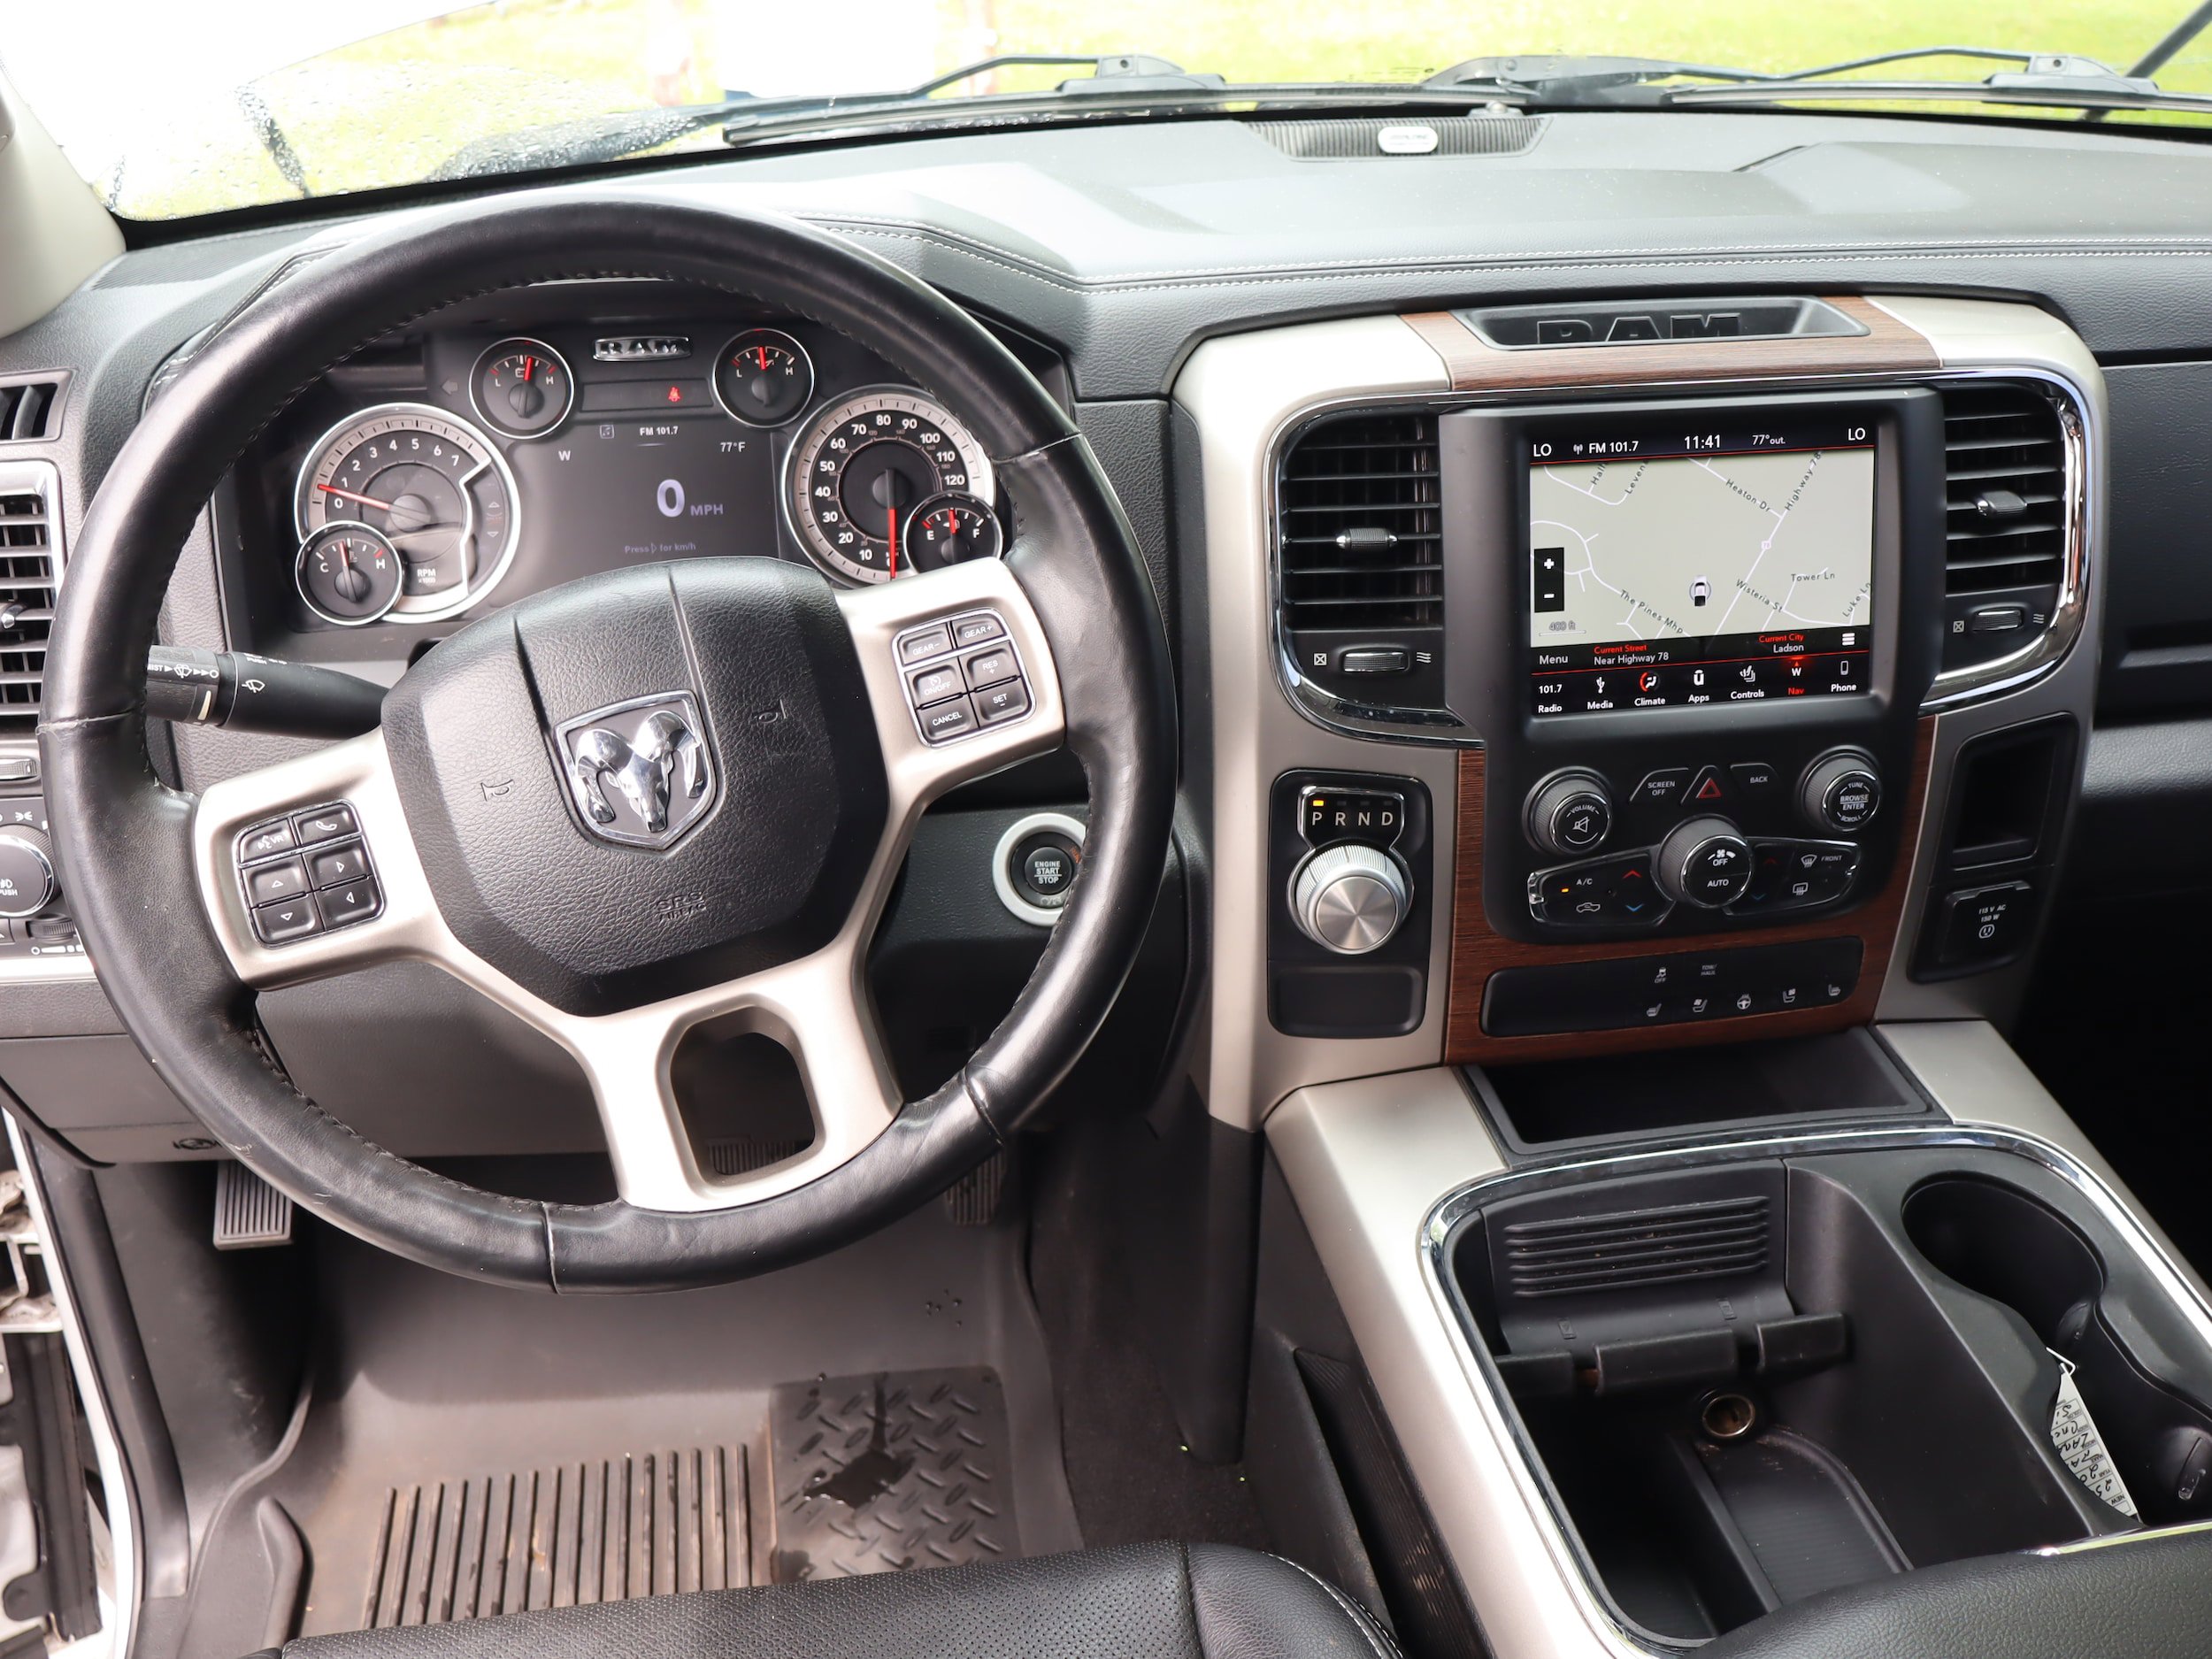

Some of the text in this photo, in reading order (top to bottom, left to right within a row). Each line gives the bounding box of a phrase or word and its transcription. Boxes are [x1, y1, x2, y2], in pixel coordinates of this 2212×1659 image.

[1537, 312, 1740, 345] RAM
[786, 367, 794, 376] H
[876, 415, 891, 426] 80
[902, 419, 918, 430] 90
[640, 426, 679, 436] FM 101.7
[851, 424, 867, 435] 70
[1847, 427, 1866, 441] LO
[411, 438, 419, 450] 5
[830, 438, 846, 449] 60
[919, 433, 941, 444] 100
[1684, 434, 1721, 449] 11:41
[388, 439, 397, 450] 4
[720, 442, 746, 453] 77°F
[1533, 443, 1552, 457] LO
[1588, 441, 1639, 454] FM 101.7
[370, 447, 378, 458] 3
[434, 445, 442, 457] 6
[558, 450, 571, 461] W
[936, 451, 956, 462] 110
[352, 459, 361, 472] 2
[451, 455, 459, 466] 7
[819, 461, 835, 472] 50
[342, 477, 348, 488] 1
[944, 474, 965, 485] 120
[1784, 452, 1822, 511] Highway 78
[815, 487, 831, 497] 40
[1725, 479, 1770, 512] Heaton Dr
[334, 497, 343, 509] 0
[657, 479, 724, 518] 0 MPH
[822, 511, 838, 523] 30
[838, 533, 853, 543] 20
[926, 530, 934, 541] E
[972, 528, 980, 539] F
[625, 544, 649, 554] Press
[674, 541, 696, 551] km/h
[858, 549, 872, 560] 10
[319, 563, 329, 573] C
[375, 558, 386, 570] H
[417, 568, 436, 577] RPM
[1791, 572, 1835, 582] Tower Ln
[1736, 579, 1783, 613] Wisteria St
[1842, 581, 1871, 618] Luke Ln
[1620, 589, 1684, 634] The Pines Mhp
[1568, 620, 1576, 630] ft
[1758, 633, 1804, 643] Current City
[1773, 643, 1804, 654] Ladson
[1539, 655, 1569, 664] Menu
[1594, 652, 1669, 665] Near Highway 78
[982, 659, 998, 671] RES
[1538, 684, 1563, 695] 101.7
[1831, 683, 1856, 693] Phone
[993, 693, 1007, 704] SET
[1688, 695, 1709, 704] Apps
[1730, 688, 1764, 700] Controls
[1586, 700, 1613, 710] Media
[1634, 697, 1666, 707] Climate
[1538, 704, 1563, 713] Radio
[932, 711, 963, 726] CANCEL
[1840, 794, 1870, 803] BROWSE
[1571, 804, 1596, 814] VOLUME
[1311, 812, 1394, 826] P R N D
[1712, 858, 1729, 867] OFF
[1707, 879, 1730, 887] AUTO
[2110, 1494, 2125, 1505] NEW
